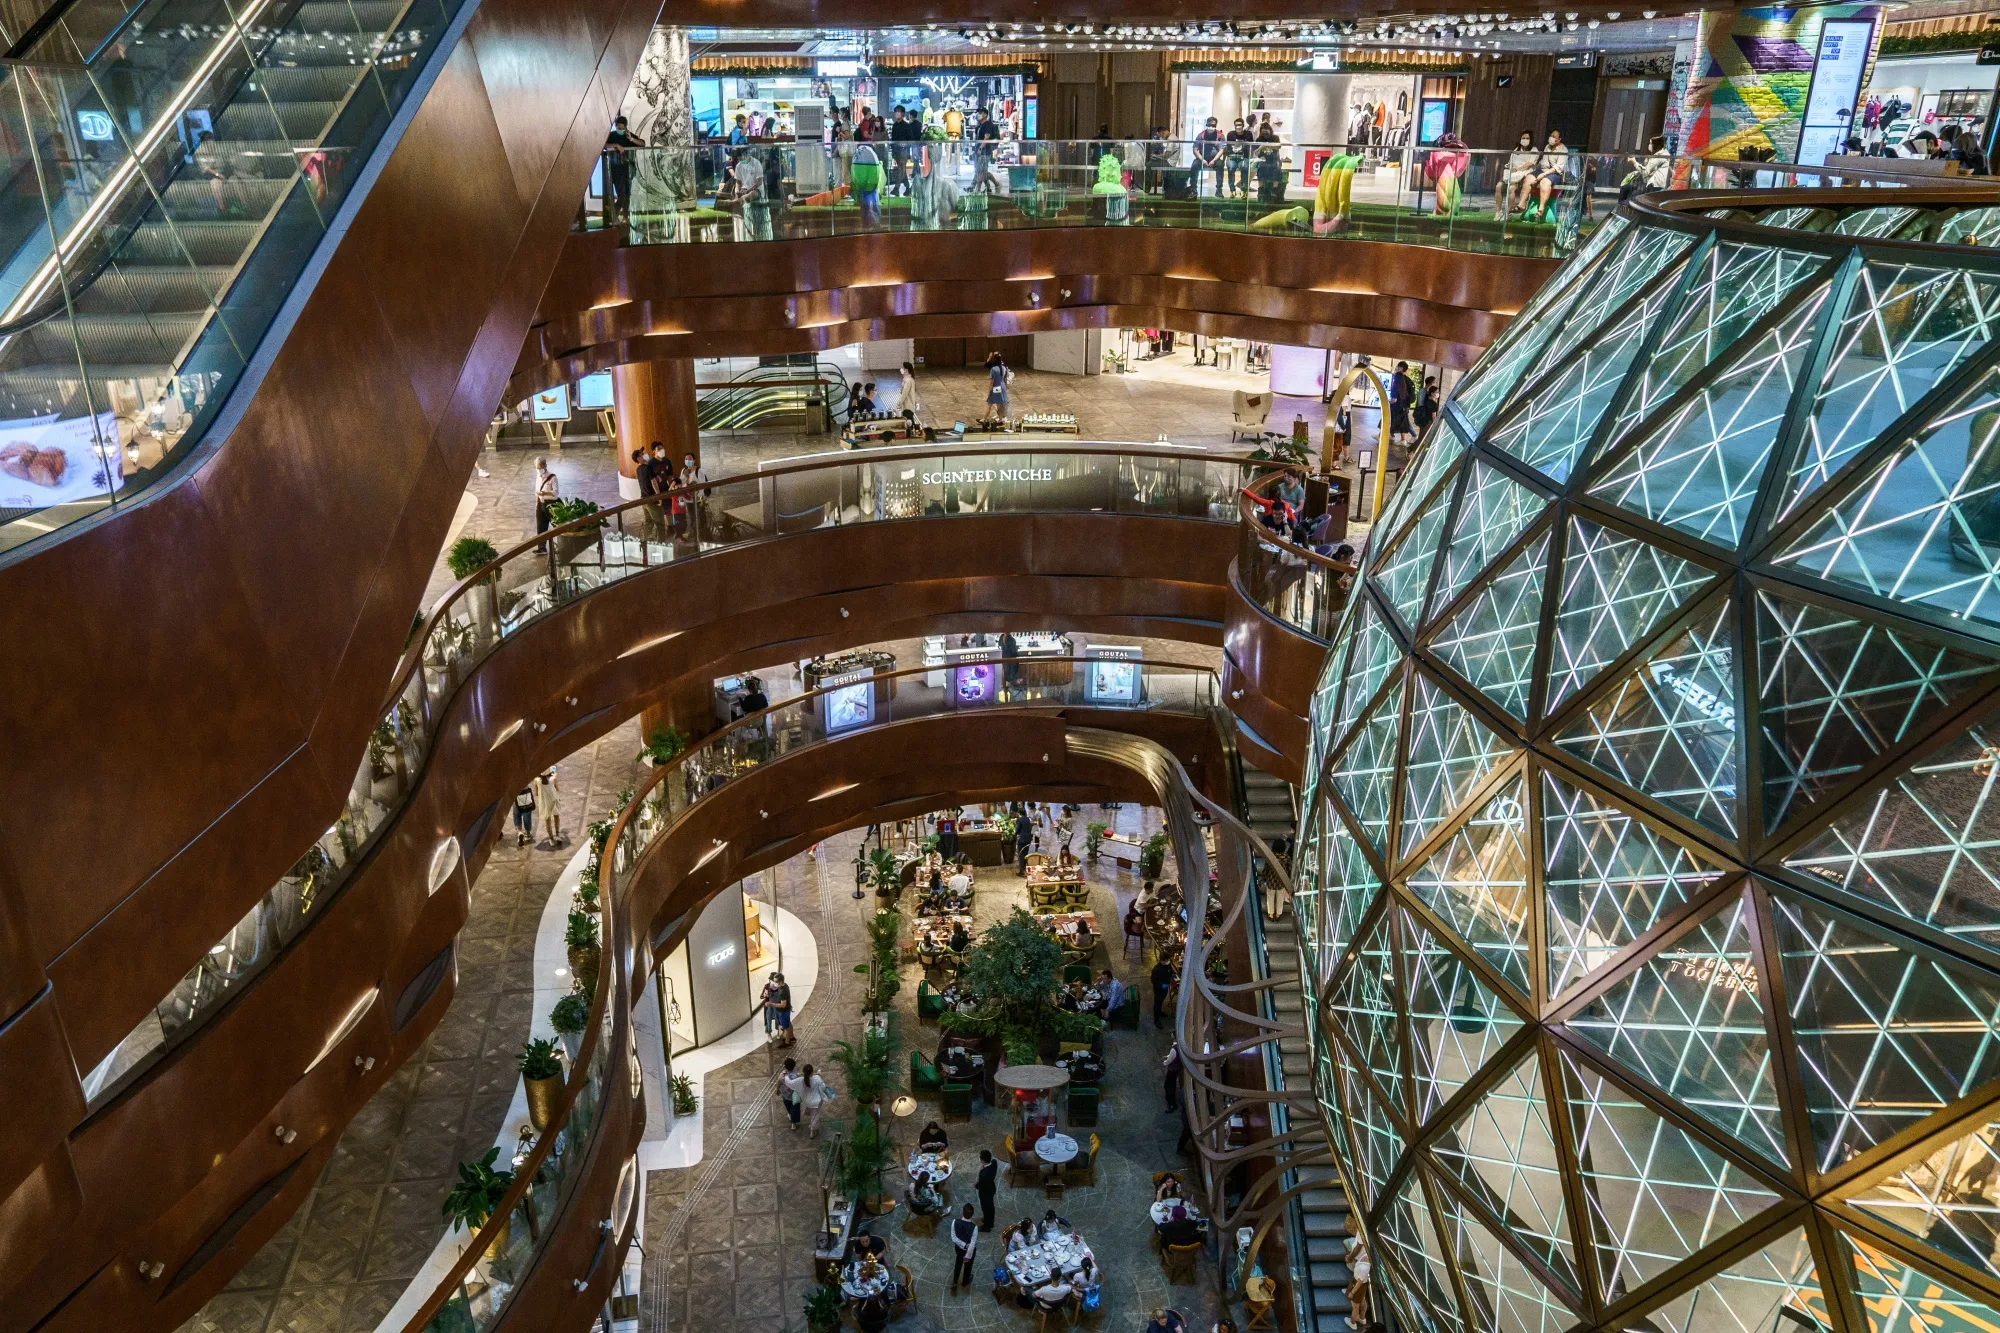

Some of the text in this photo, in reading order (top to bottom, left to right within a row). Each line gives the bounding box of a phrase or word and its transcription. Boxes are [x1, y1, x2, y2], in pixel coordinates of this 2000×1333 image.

[922, 468, 1052, 485] SCENTED NICHE
[960, 652, 989, 660] GOUTAL
[834, 672, 861, 684] GOUTAL
